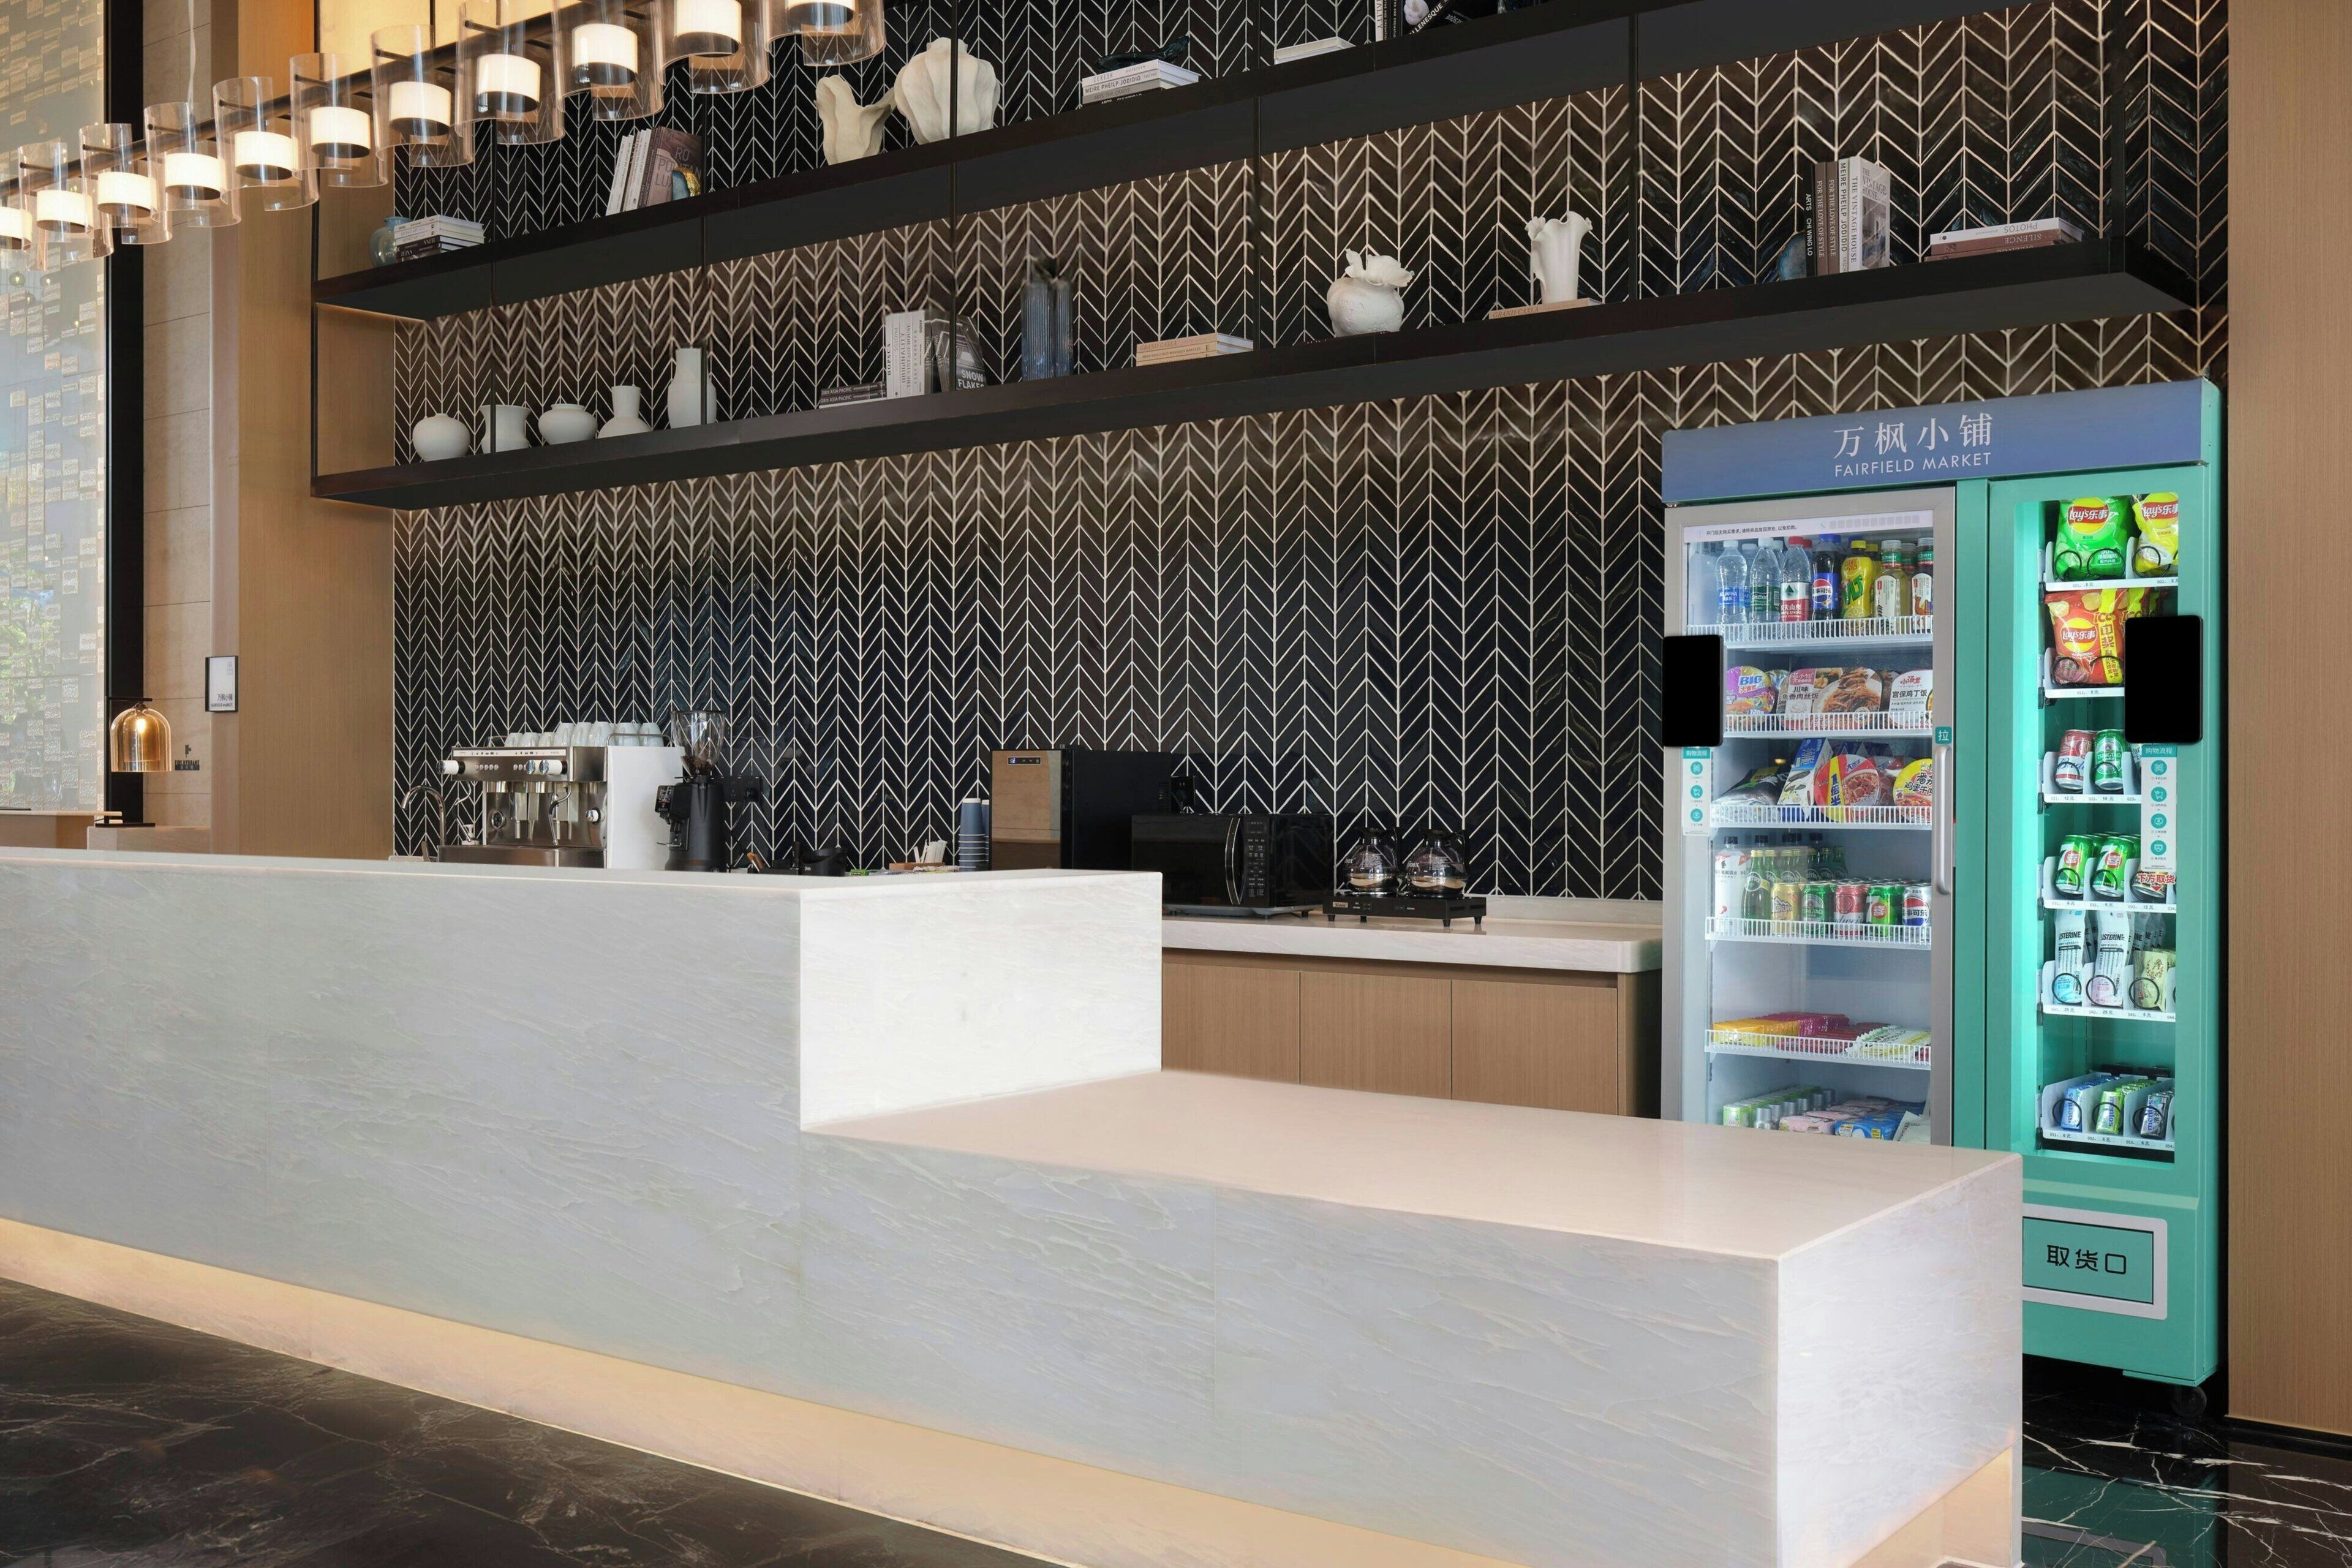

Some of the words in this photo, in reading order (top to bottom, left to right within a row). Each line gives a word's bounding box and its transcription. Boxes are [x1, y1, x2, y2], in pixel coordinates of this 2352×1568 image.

[1409, 2, 1444, 35] LENESQUE
[1101, 81, 1119, 91] PHEILP
[1120, 75, 1141, 86] JODIDIO
[676, 147, 690, 162] RO
[1863, 175, 1887, 195] VINTAGE
[1863, 187, 1879, 200] HOUSE
[1818, 227, 1823, 236] OF
[1830, 226, 1835, 236] OF
[2003, 222, 2038, 233] PHOTOS
[2004, 233, 2042, 244] SILENCE
[1807, 247, 1813, 256] LO
[1493, 309, 1517, 318] GRAND
[961, 369, 983, 382] SNOW
[1833, 412, 1993, 459] 万枫小铺
[1834, 459, 1915, 478] FAIRFIELD
[1922, 451, 1991, 470] MARKET
[1739, 675, 1762, 685] BIG
[1892, 689, 1928, 698] 宫保鸡丁饭
[1938, 729, 1949, 741] 拉
[2138, 873, 2175, 884] 下方取货
[2046, 1244, 2127, 1275] 取货口
